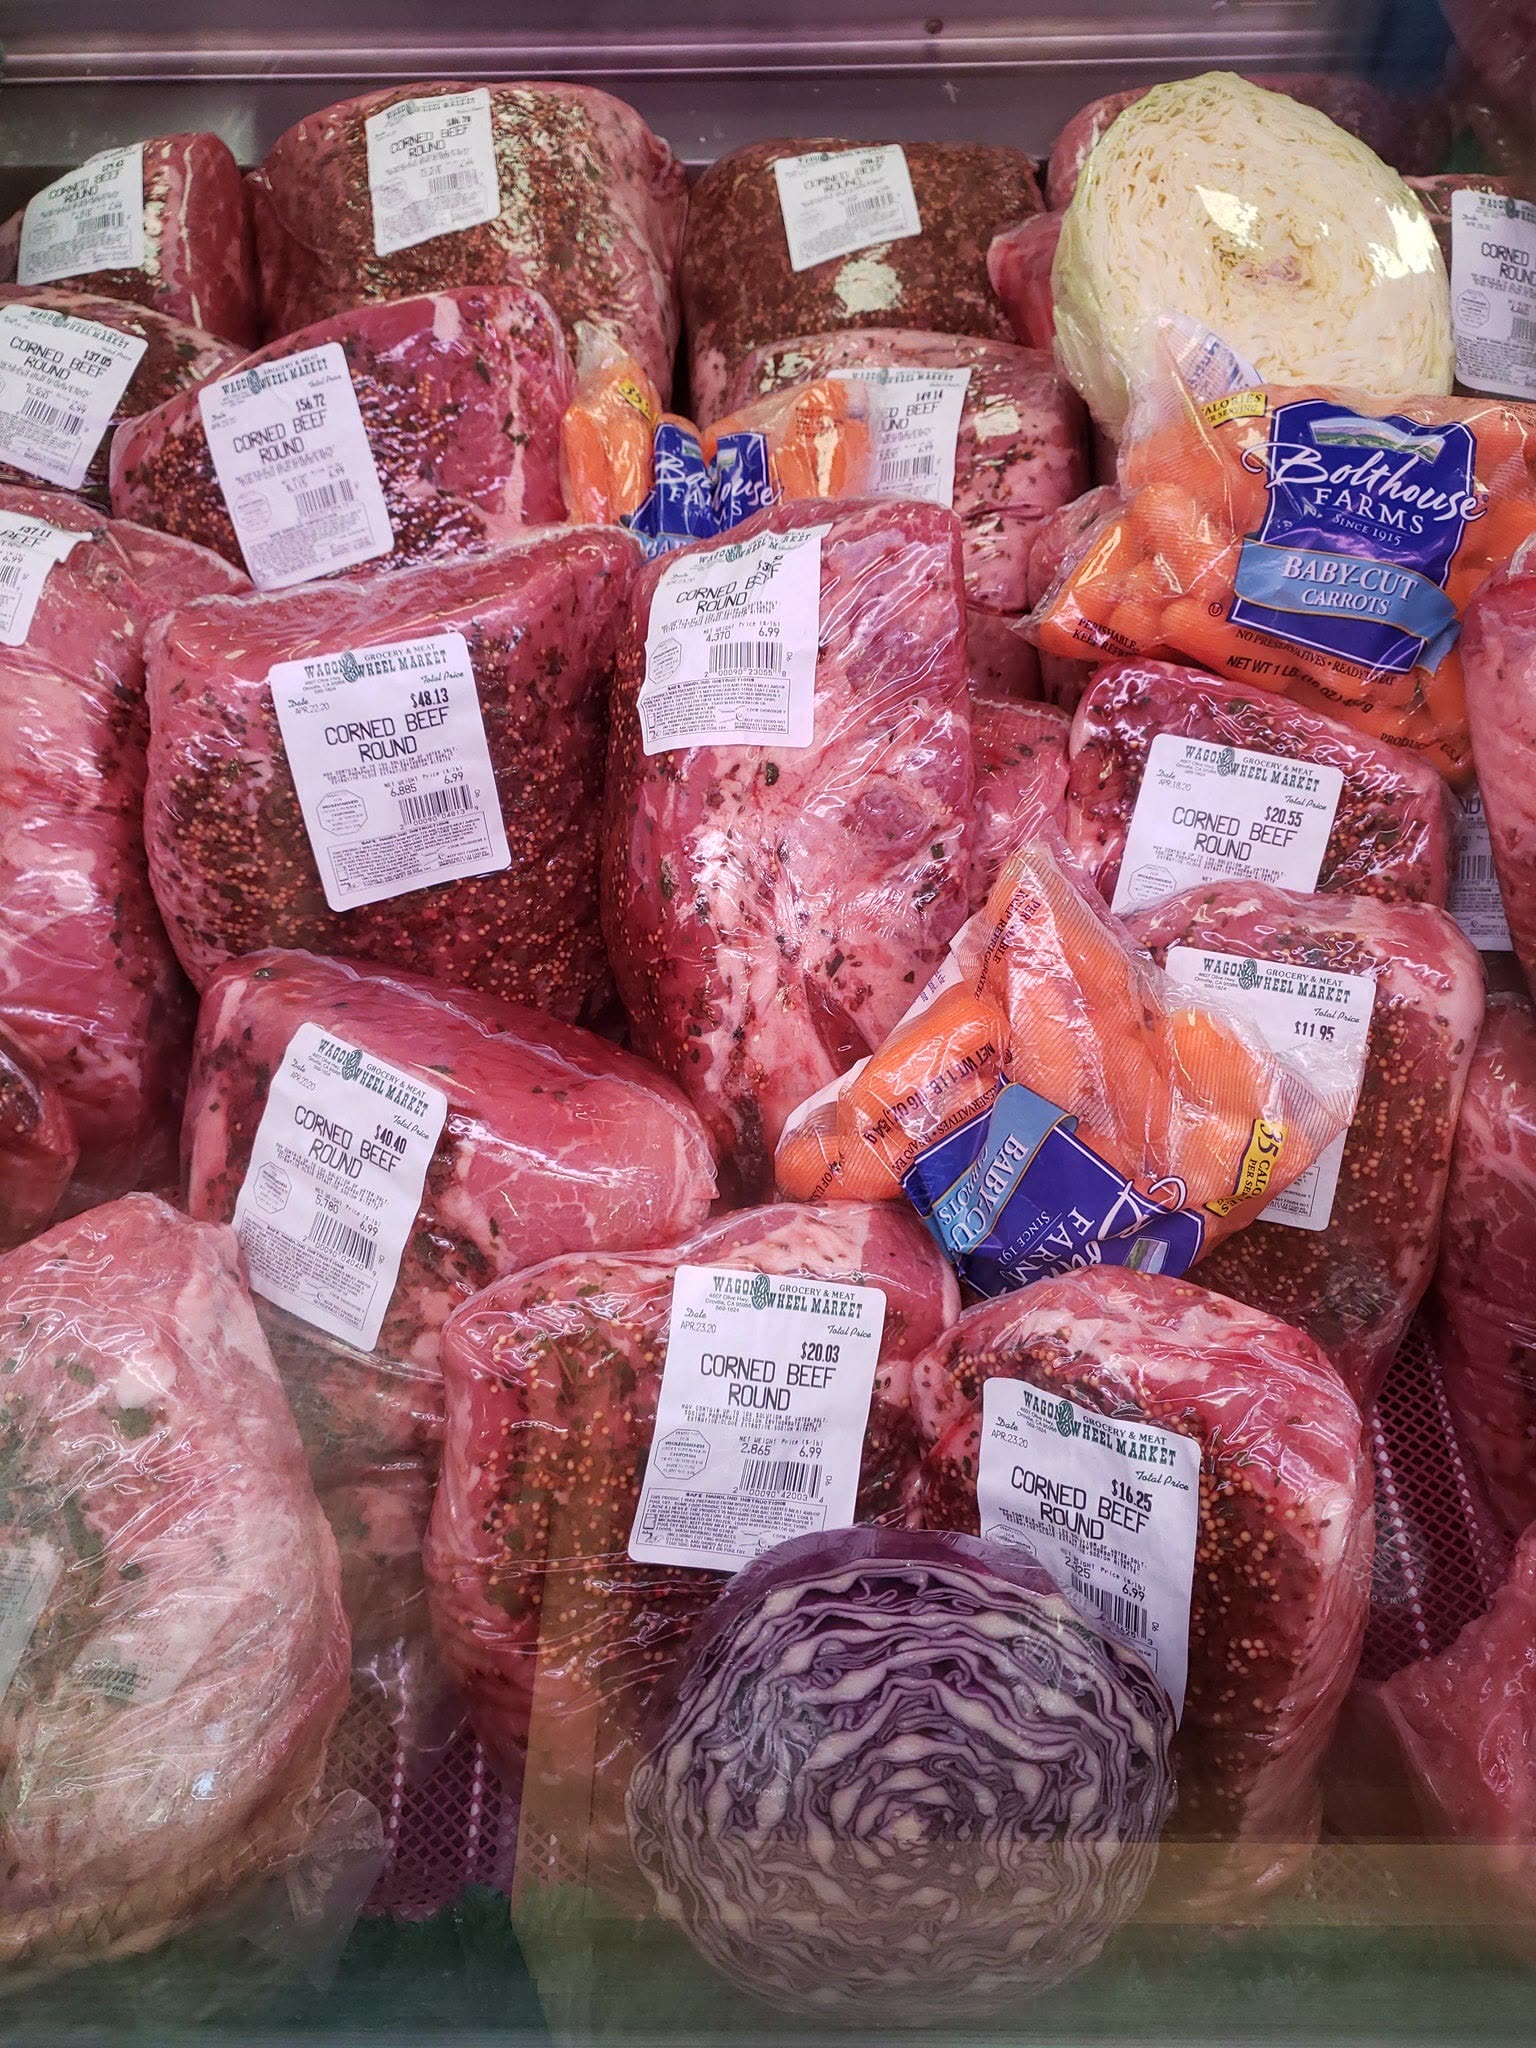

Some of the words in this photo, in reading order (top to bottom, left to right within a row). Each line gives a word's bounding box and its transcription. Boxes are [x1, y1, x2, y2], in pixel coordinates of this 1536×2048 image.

[390, 131, 434, 154] CORNED
[441, 126, 468, 139] BEEF
[409, 139, 446, 157] ROUND
[1482, 242, 1529, 267] CORNED
[10, 335, 64, 363] CORNED
[69, 356, 108, 379] BEEF
[24, 355, 71, 380] ROUND
[290, 358, 329, 380] MARKET
[907, 401, 942, 417] BEEF
[232, 422, 286, 453] CORNED
[292, 409, 328, 434] BEEF
[258, 437, 305, 465] ROUND
[1242, 442, 1488, 522] Bolthouse
[1313, 486, 1424, 535] FARMS
[1333, 512, 1369, 535] SINCE
[1372, 527, 1402, 546] 1915
[1282, 555, 1419, 601] BABY-CUT
[676, 580, 738, 604] CORNED
[695, 591, 748, 616] ROUND
[1301, 587, 1392, 617] CARROTS
[705, 630, 731, 643] 4.370
[758, 626, 780, 638] 6.99
[414, 643, 437, 654] MEAT
[1235, 629, 1253, 642] NO
[1255, 633, 1328, 667] PRESERVATIVES
[304, 657, 347, 679] WAGON
[354, 659, 397, 679] WHEEL
[399, 650, 448, 672] MARKET
[421, 671, 443, 684] Total
[443, 670, 464, 681] Price
[1226, 655, 1253, 671] NET
[1252, 659, 1274, 675] WT
[1274, 664, 1282, 675] 1
[410, 687, 450, 709] $48.13
[324, 717, 396, 746] CORNED
[404, 705, 450, 733] BEEF
[358, 735, 418, 763] ROUND
[1185, 744, 1224, 764] WAGON
[1230, 761, 1268, 781] WHEEL
[1270, 769, 1321, 793] MARKET
[1242, 756, 1283, 771] GROCERY
[1291, 765, 1314, 777] MEAT
[390, 782, 418, 798] 6.885
[444, 772, 465, 785] 6.99
[1285, 794, 1305, 807] Total
[1305, 799, 1327, 812] Price
[1172, 806, 1241, 837] CORNED
[1249, 822, 1298, 848] BEEF
[1264, 805, 1304, 828] $20.55
[1193, 832, 1253, 861] ROUND
[1203, 957, 1246, 978] WAGON
[1266, 968, 1309, 981] GROCERY
[1318, 977, 1344, 988] MEAT
[1251, 973, 1295, 994] WHEEL
[1298, 981, 1352, 1005] MARKET
[1314, 1007, 1337, 1019] Total
[1337, 1011, 1360, 1023] Price
[1294, 1021, 1336, 1043] $11.95
[318, 1038, 352, 1066] WAGON
[975, 1041, 996, 1066] NET
[958, 1056, 979, 1079] WT
[354, 1067, 386, 1096] WHEEL
[385, 1084, 429, 1118] MARKET
[366, 1063, 400, 1086] GROCERY
[406, 1084, 426, 1099] MEAT
[294, 1105, 353, 1151] CORNED
[359, 1139, 402, 1173] BEEF
[394, 1114, 412, 1130] Total
[411, 1124, 430, 1139] Price
[374, 1124, 408, 1155] $40.40
[1257, 1122, 1284, 1158] 35
[308, 1138, 363, 1179] ROUND
[1246, 1158, 1257, 1179] PER
[314, 1194, 340, 1214] 5.780
[359, 1220, 380, 1237] 6.99
[1016, 1211, 1051, 1248] SINCE
[713, 1275, 759, 1296] WAGON
[779, 1284, 822, 1296] GROCERY
[832, 1290, 856, 1300] MEAT
[684, 1308, 707, 1319] Date
[766, 1291, 808, 1311] WHEEL
[810, 1298, 863, 1319] MARKET
[827, 1324, 850, 1336] Total
[849, 1328, 872, 1339] Price
[800, 1340, 841, 1364] $20.03
[700, 1353, 776, 1383] CORNED
[786, 1363, 836, 1389] BEEF
[728, 1382, 791, 1411] ROUND
[1023, 1390, 1063, 1421] WAGON
[995, 1416, 1018, 1432] Date
[1082, 1415, 1126, 1439] GROCERY
[1128, 1431, 1137, 1440] &
[1139, 1433, 1167, 1446] MEAT
[740, 1442, 772, 1457] 2.865
[799, 1446, 823, 1459] 6.99
[754, 1437, 776, 1445] WEIGHT
[781, 1438, 798, 1446] Price
[991, 1429, 1029, 1449] APR.23.20
[1070, 1421, 1113, 1450] WHEEL
[1116, 1438, 1177, 1467] MARKET
[1135, 1470, 1163, 1484] Total
[1163, 1476, 1190, 1491] Price
[749, 1488, 777, 1499] 00090
[1010, 1465, 1087, 1511] CORNED
[1098, 1496, 1150, 1534] BEEF
[1111, 1479, 1153, 1512] $16.25
[1040, 1501, 1105, 1540] ROUND
[1100, 1566, 1121, 1581] Price
[1121, 1583, 1146, 1603] 6.99
